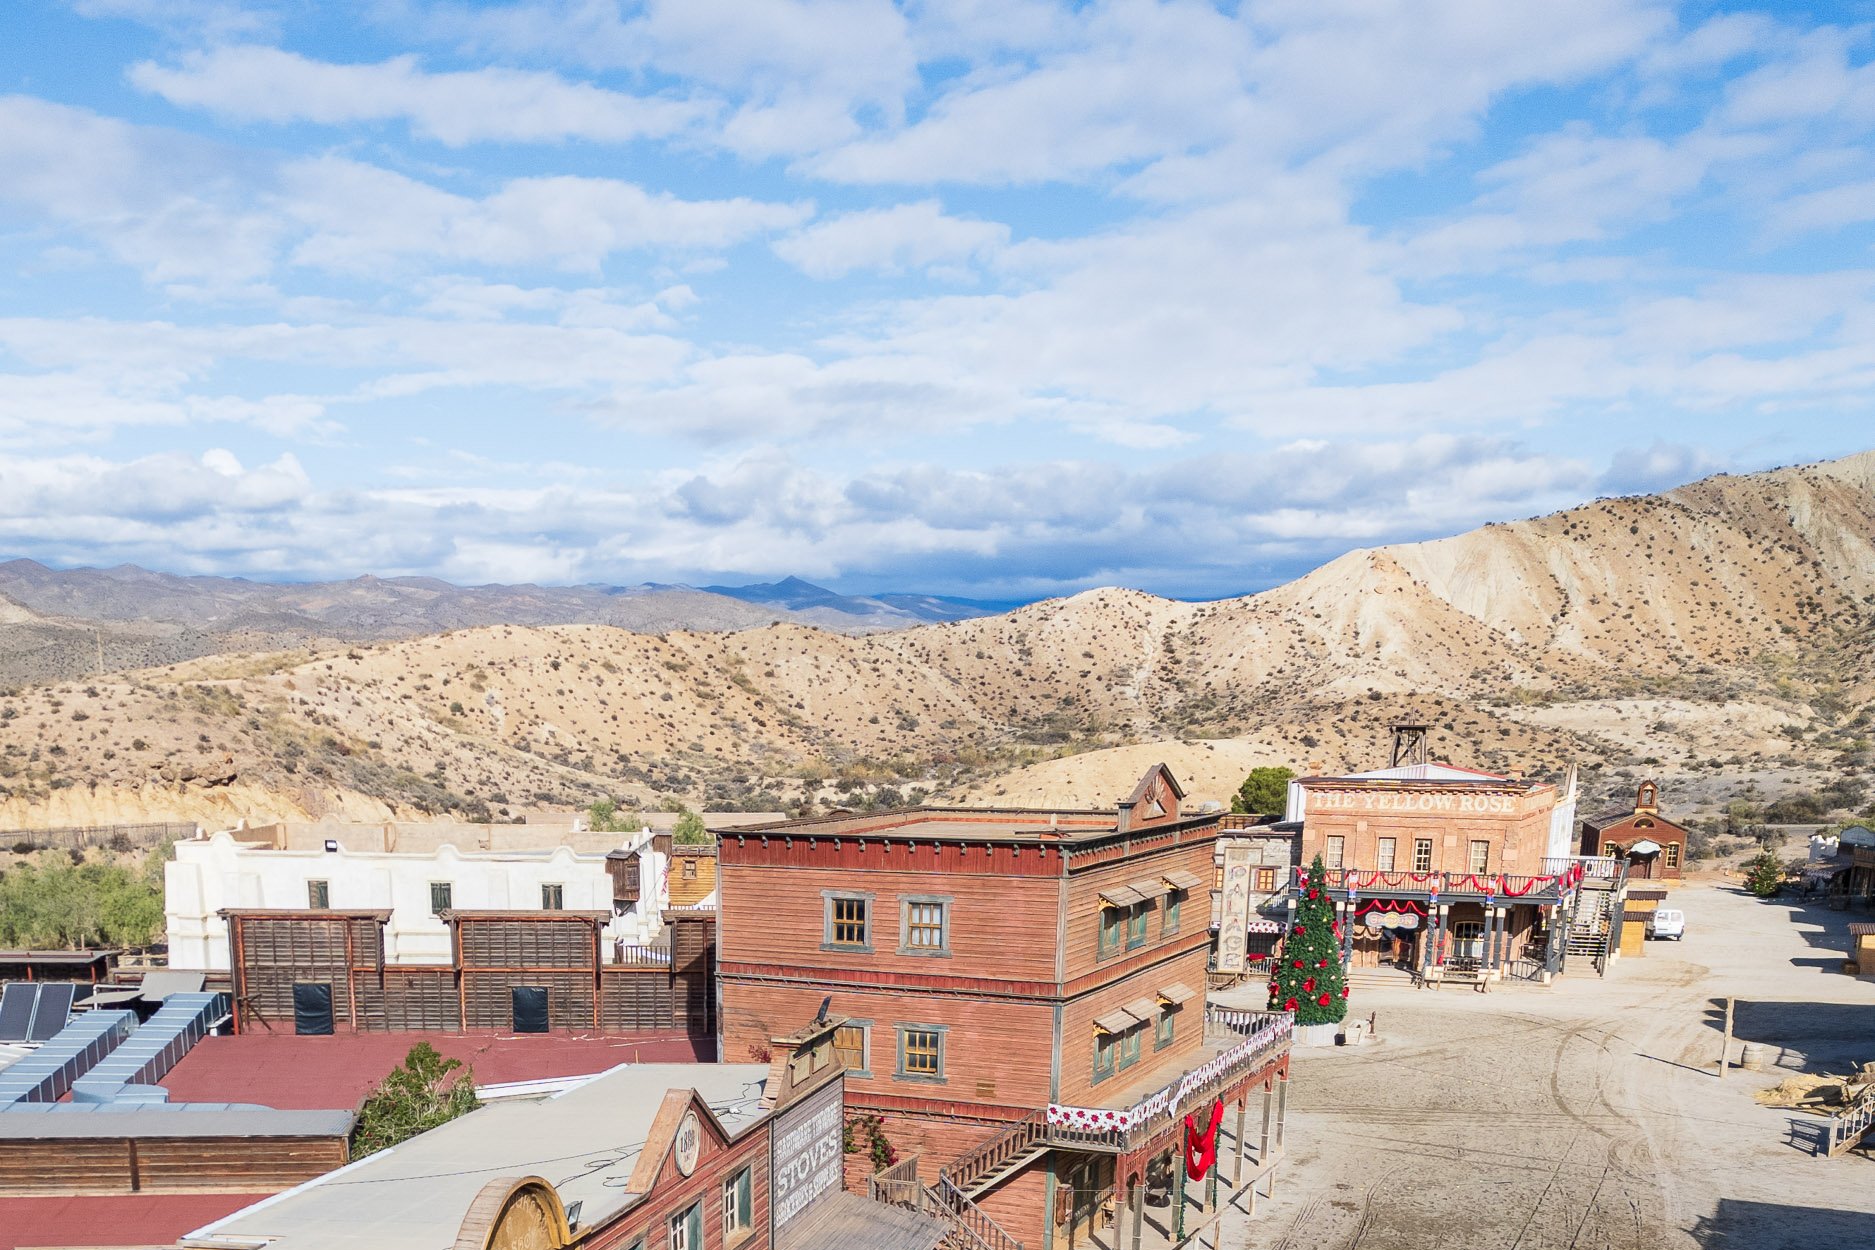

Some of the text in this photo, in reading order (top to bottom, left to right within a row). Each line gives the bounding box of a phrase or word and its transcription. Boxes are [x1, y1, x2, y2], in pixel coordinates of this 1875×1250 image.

[1312, 792, 1355, 808] THE
[1363, 792, 1454, 811] YELLOW
[1458, 795, 1517, 813] ROSE
[777, 1129, 838, 1198] STOVES
